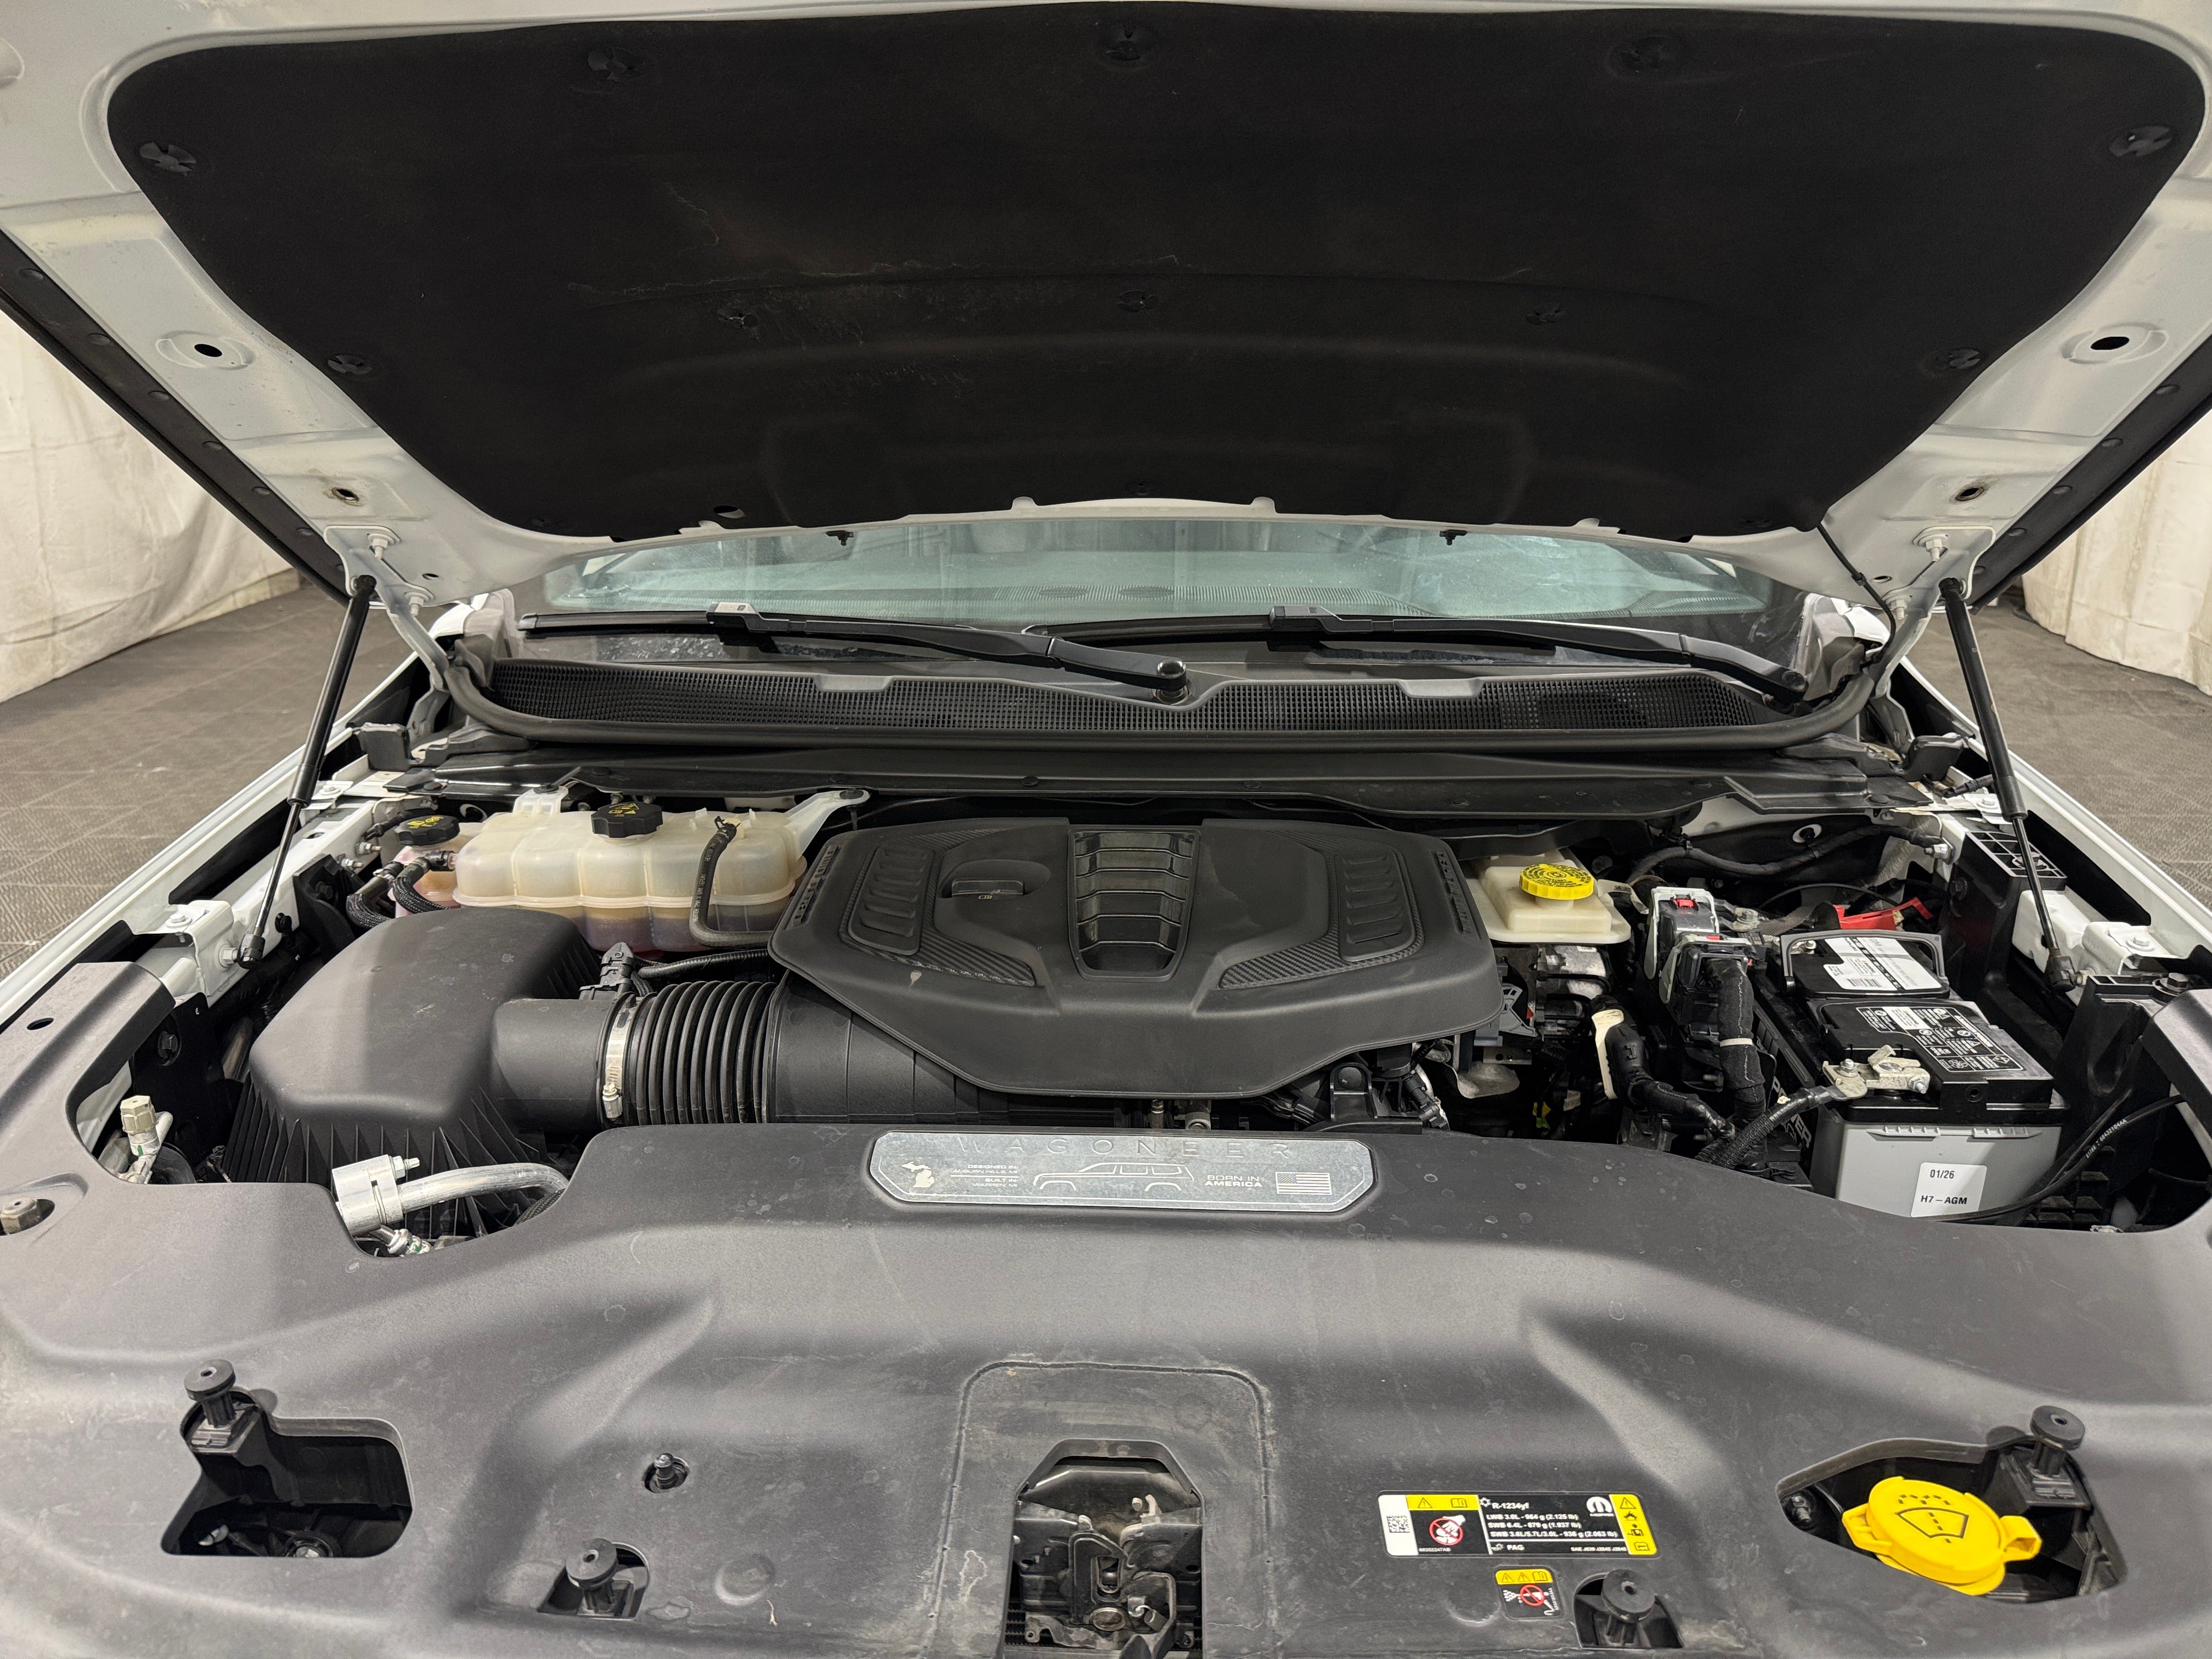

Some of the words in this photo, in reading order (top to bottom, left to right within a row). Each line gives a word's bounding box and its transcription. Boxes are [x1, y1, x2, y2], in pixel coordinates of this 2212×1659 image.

[956, 1136, 1289, 1159] WAGONEER
[1929, 1169, 1955, 1179] 01/26
[1920, 1195, 1934, 1203] H7
[1944, 1197, 1968, 1205] AGM
[1492, 1502, 1530, 1511] R-1234yf
